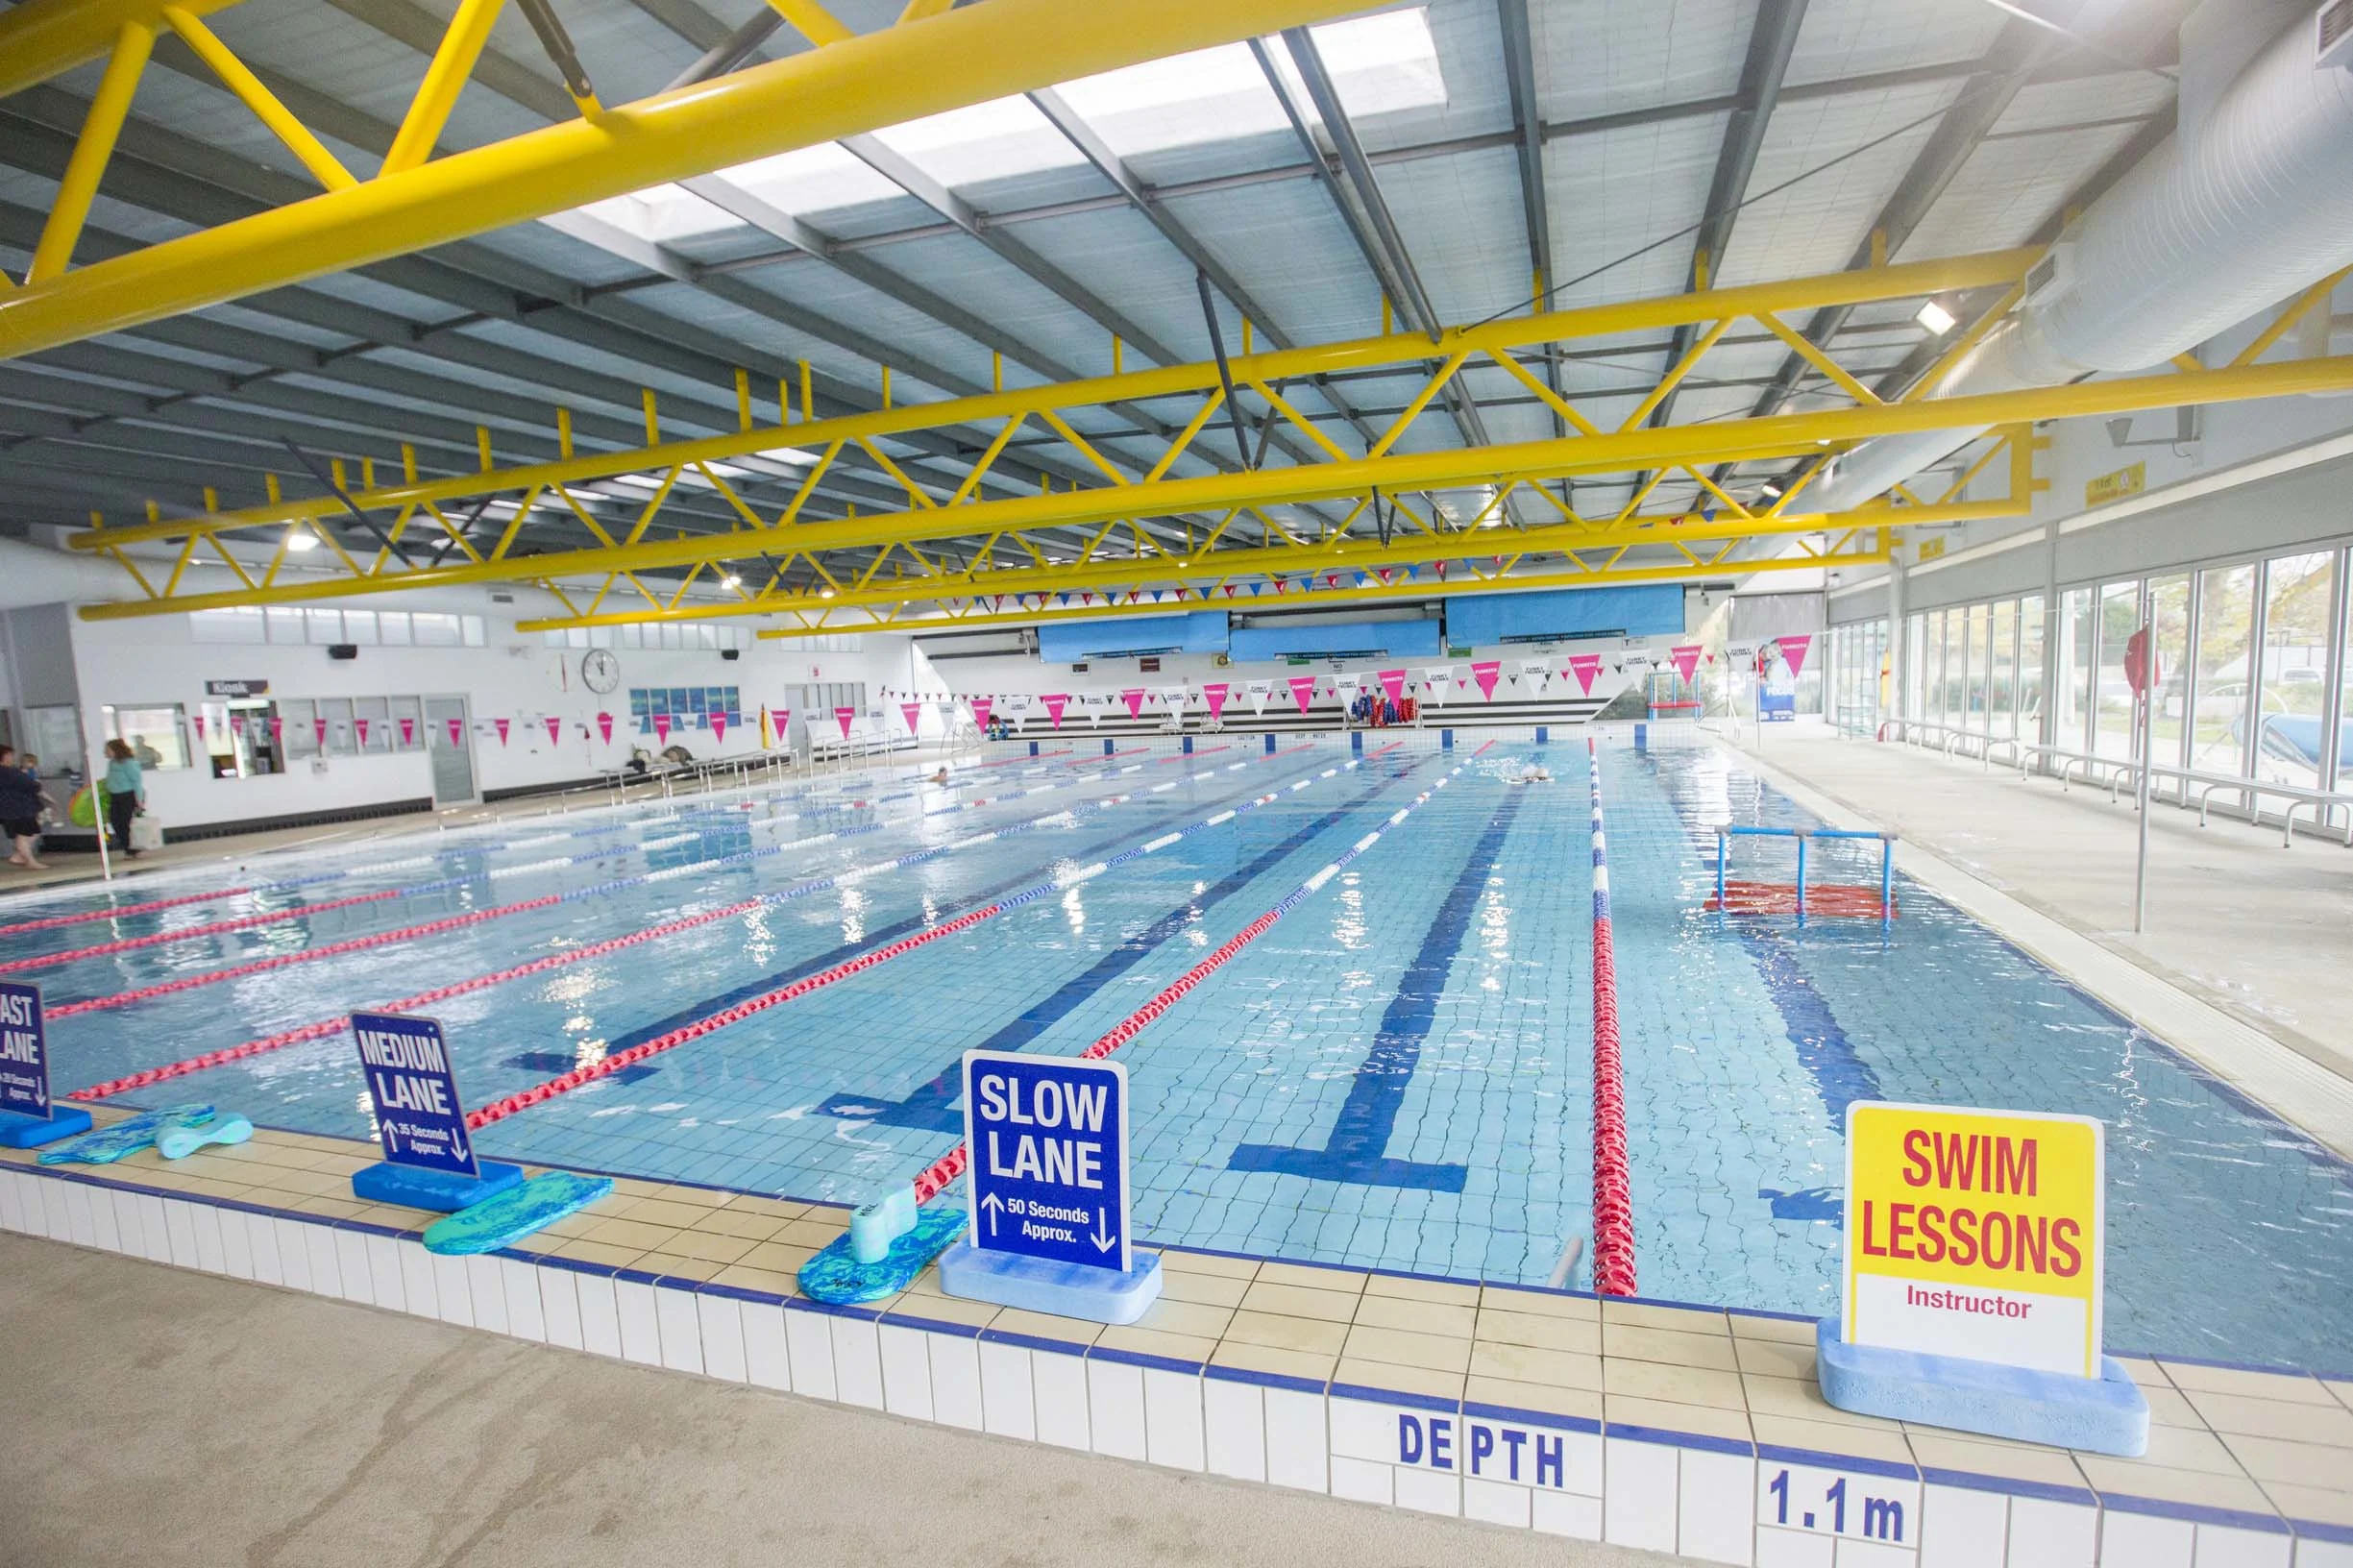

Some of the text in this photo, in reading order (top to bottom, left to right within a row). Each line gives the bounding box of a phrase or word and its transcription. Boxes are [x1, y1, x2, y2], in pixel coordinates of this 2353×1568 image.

[212, 680, 248, 694] Kiosk
[0, 993, 33, 1027] AST
[357, 1030, 447, 1073] MEDIUM
[375, 1072, 452, 1115] LANE
[980, 1074, 1108, 1133] SLOW
[398, 1122, 450, 1141] 35 Seconds
[410, 1139, 446, 1156] Approx.
[989, 1131, 1103, 1189] LANE
[1902, 1129, 2038, 1197] SWIM
[1008, 1198, 1090, 1224] 50 Seconds
[1022, 1220, 1077, 1243] Approx.
[1863, 1200, 2082, 1278] LESSONS
[1907, 1285, 2032, 1319] Instructor
[1399, 1414, 1564, 1489] DEPTH
